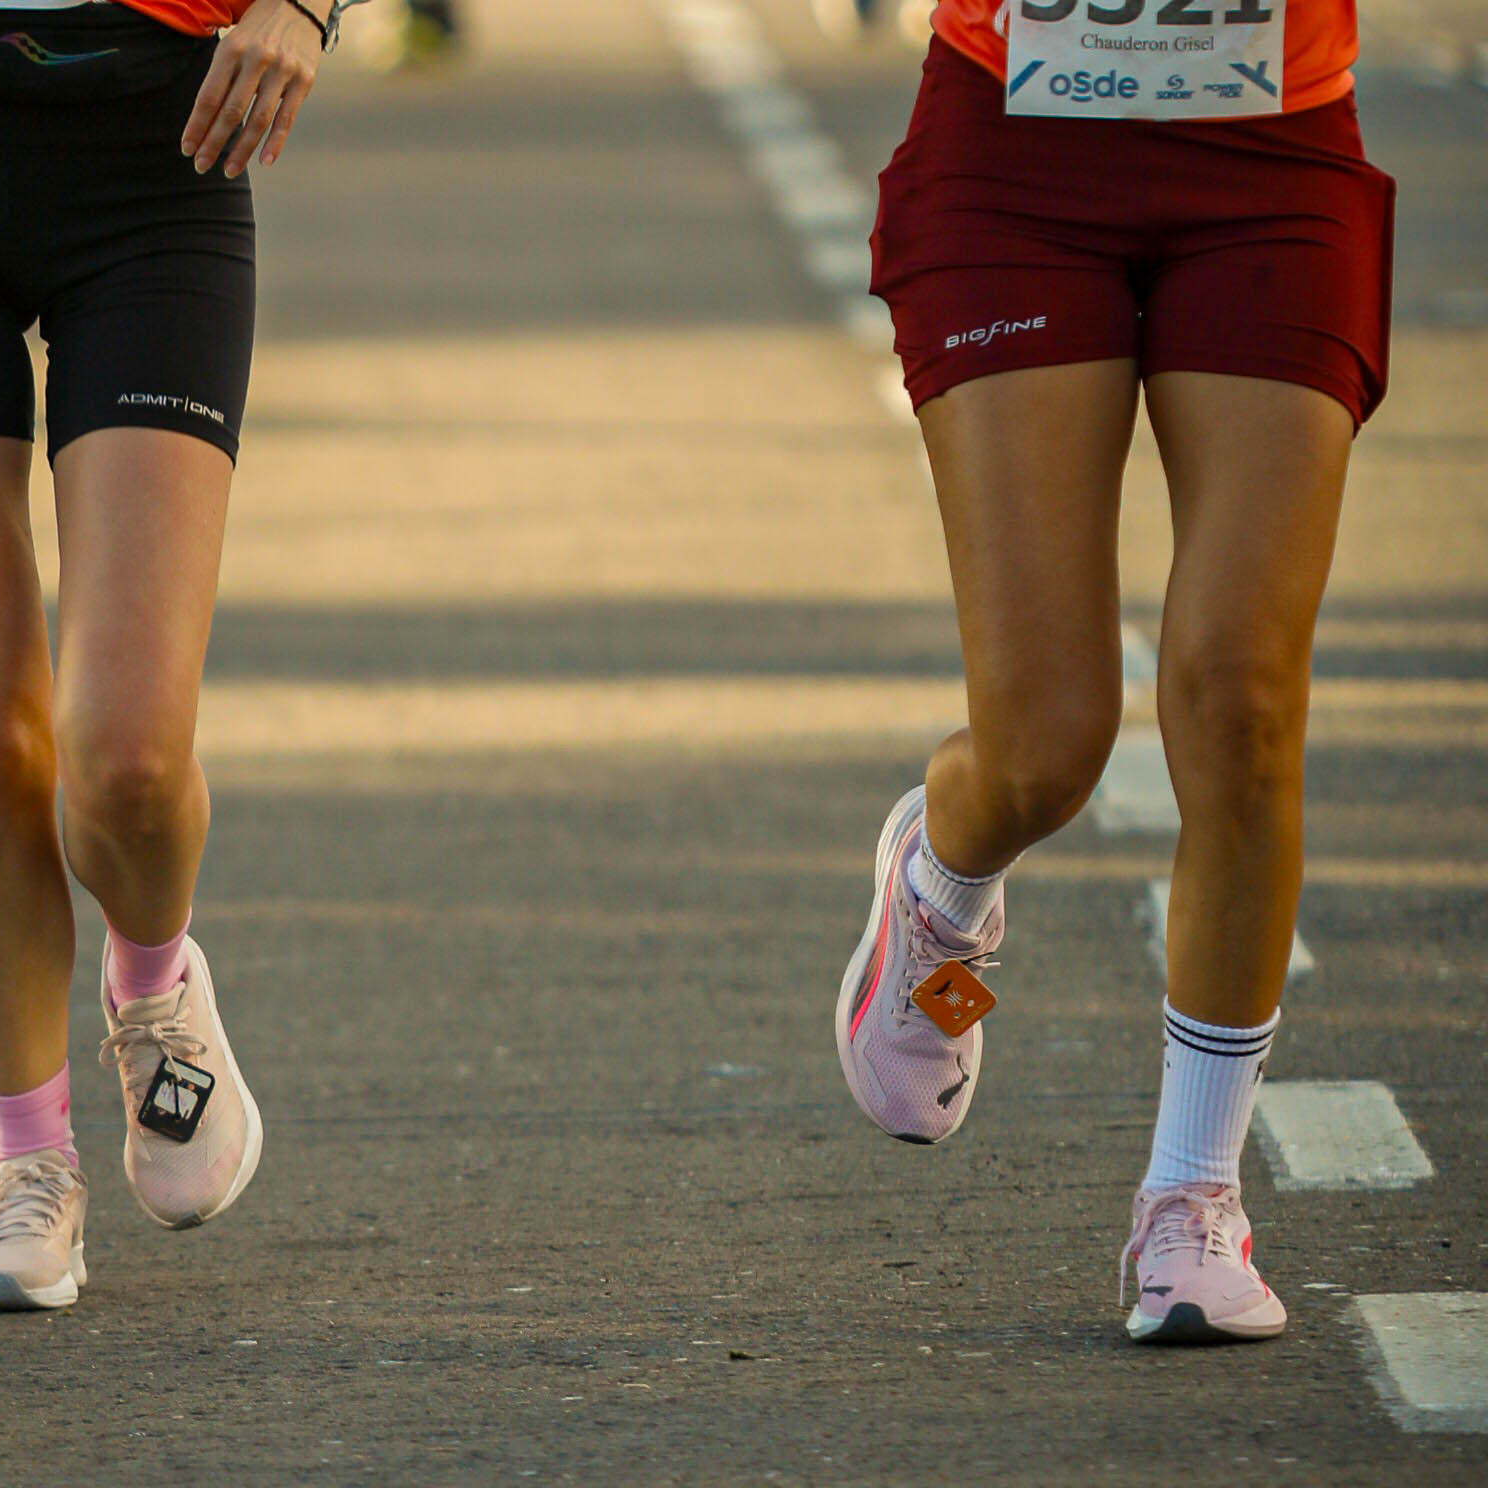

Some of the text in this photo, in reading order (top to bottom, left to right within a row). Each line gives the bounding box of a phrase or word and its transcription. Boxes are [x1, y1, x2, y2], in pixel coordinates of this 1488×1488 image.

[1081, 33, 1215, 52] Chauderon Gisel
[1049, 69, 1140, 102] osde
